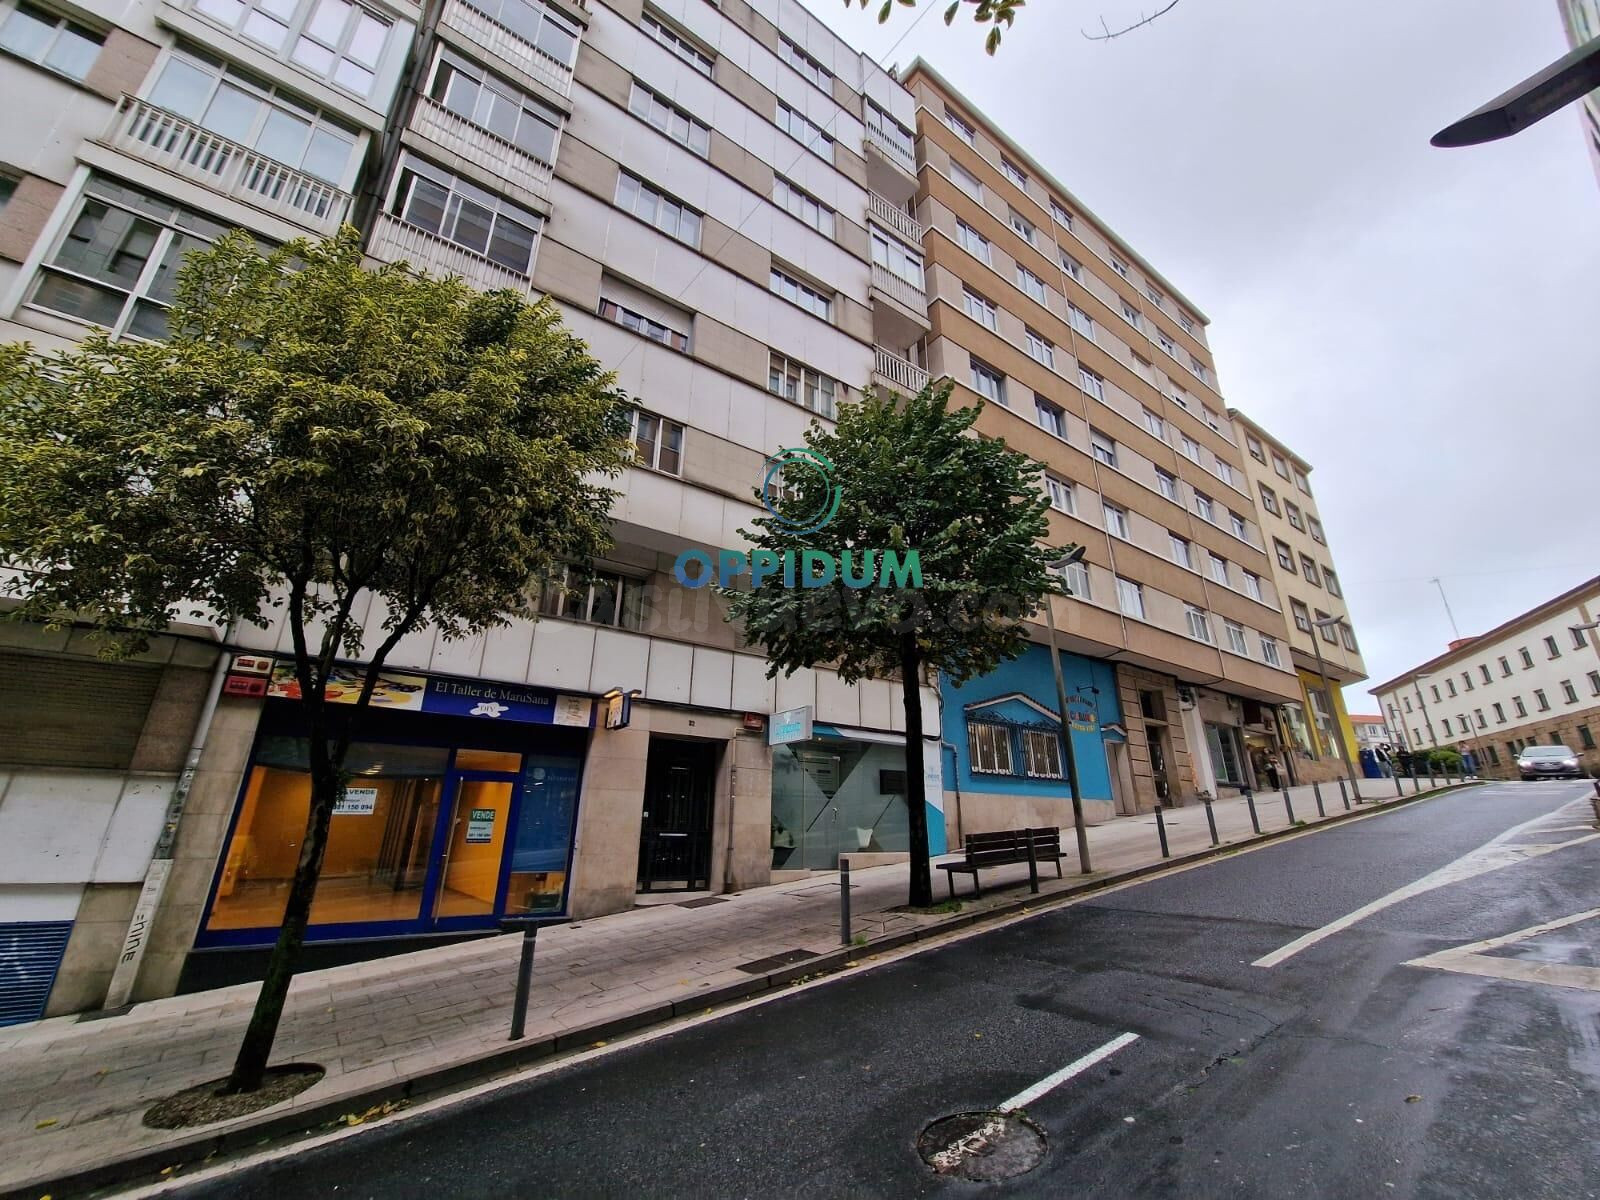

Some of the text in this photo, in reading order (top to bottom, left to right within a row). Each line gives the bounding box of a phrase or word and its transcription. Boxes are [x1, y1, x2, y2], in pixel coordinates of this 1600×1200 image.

[435, 681, 550, 705] El Taller de MaruSana
[472, 810, 495, 820] VENDE
